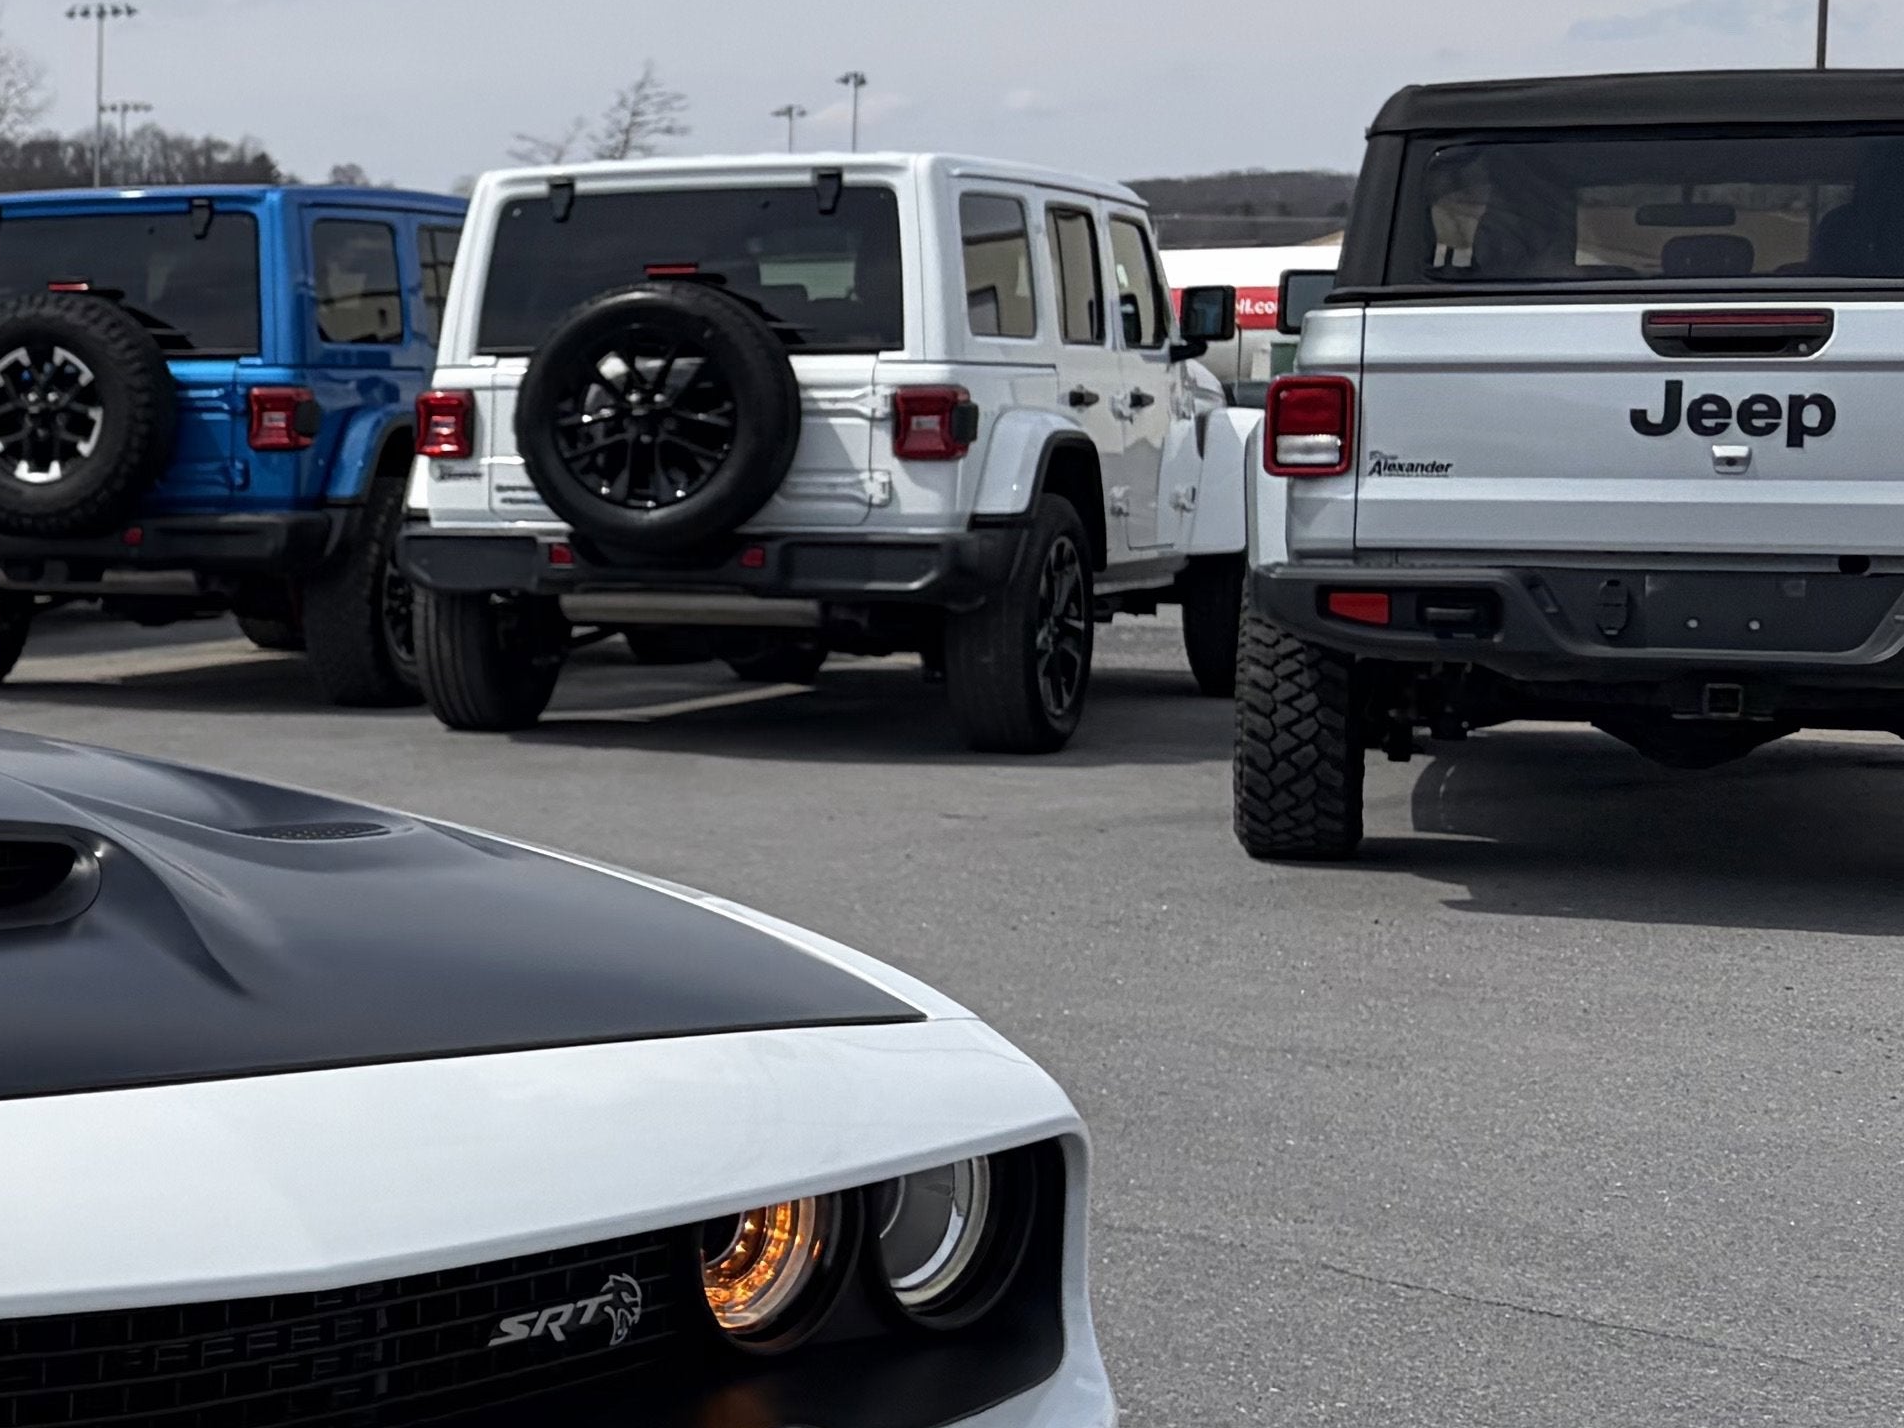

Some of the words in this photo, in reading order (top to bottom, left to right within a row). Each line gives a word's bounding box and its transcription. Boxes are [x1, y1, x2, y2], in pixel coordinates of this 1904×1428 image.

[1629, 379, 1837, 448] Jeep
[1368, 460, 1454, 477] Alexander
[487, 1294, 614, 1347] SRT
